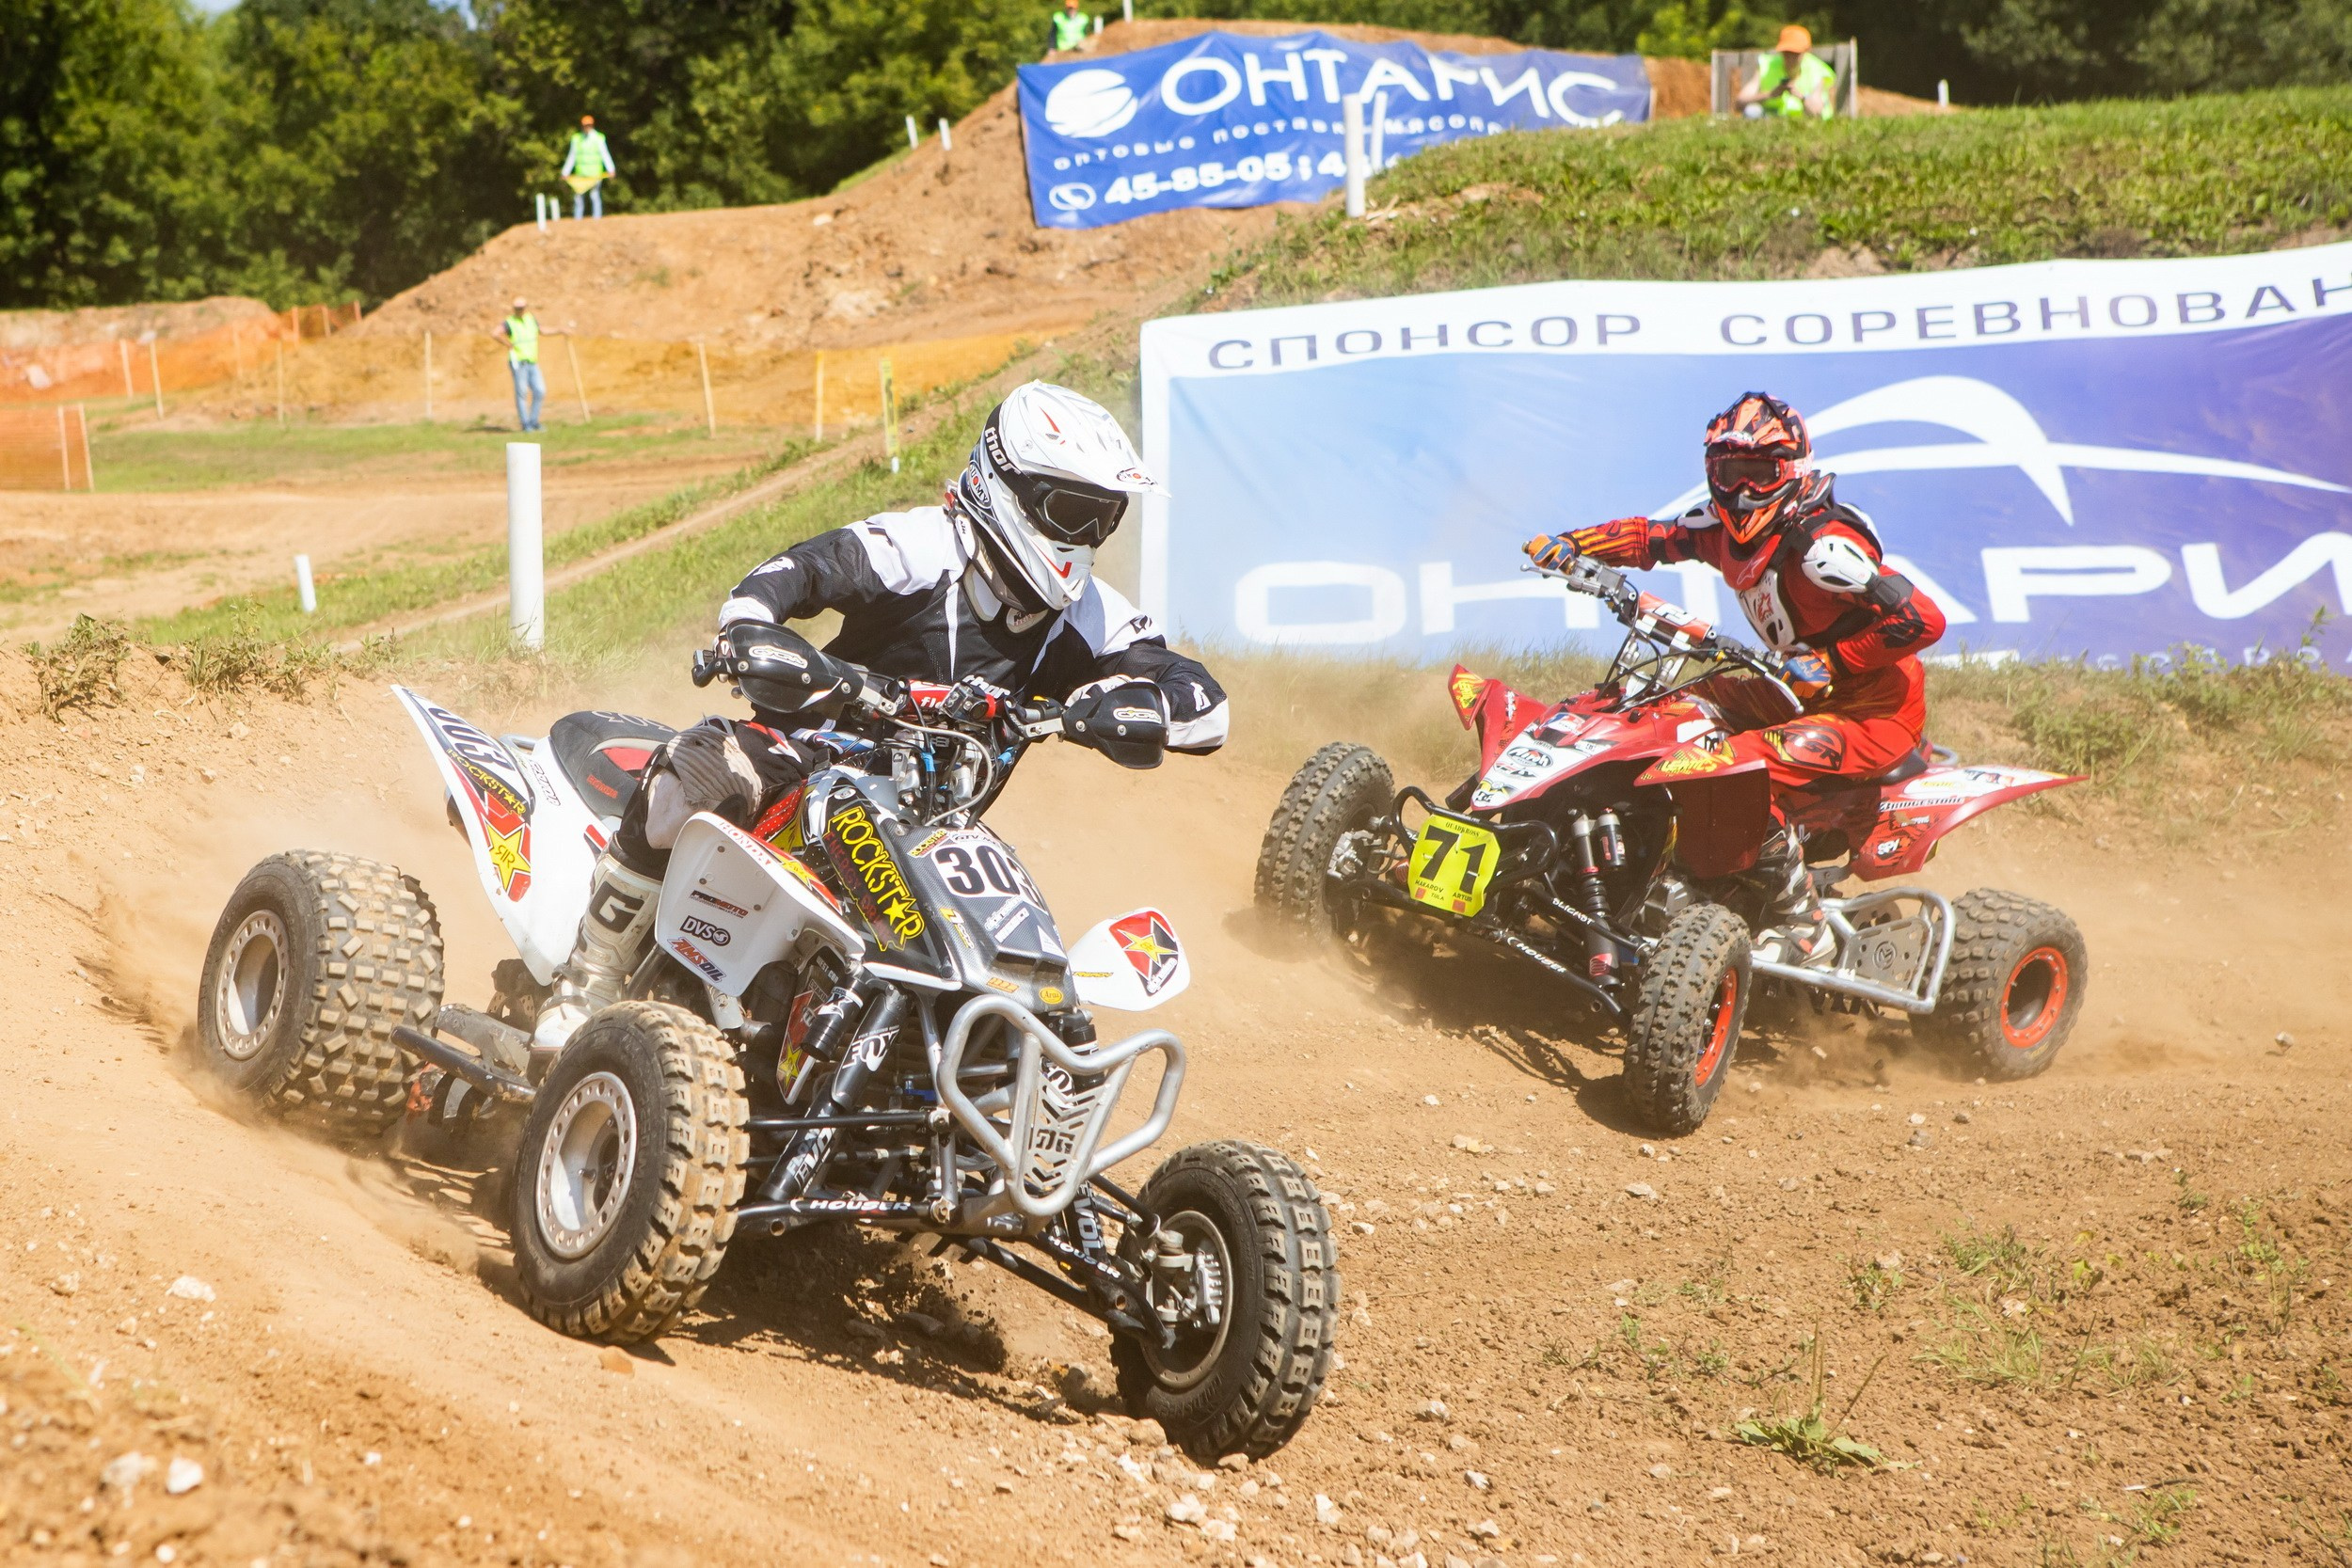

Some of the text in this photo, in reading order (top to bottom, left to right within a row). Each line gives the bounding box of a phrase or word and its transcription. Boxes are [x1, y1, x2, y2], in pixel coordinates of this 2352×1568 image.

[1208, 277, 2352, 371] СПОНСОР СОРЕВНОВАН
[1880, 797, 1964, 812] BRIDGESTONE
[1419, 824, 1487, 895] 71
[1415, 879, 1445, 894] MAKAROV
[1452, 892, 1473, 903] ARTUR
[683, 917, 714, 940] DVS
[672, 938, 724, 983] AMSOIL
[1516, 942, 1567, 974] HOUSER
[809, 1197, 912, 1212] HOUSER
[1047, 1234, 1121, 1279] HOUSER
